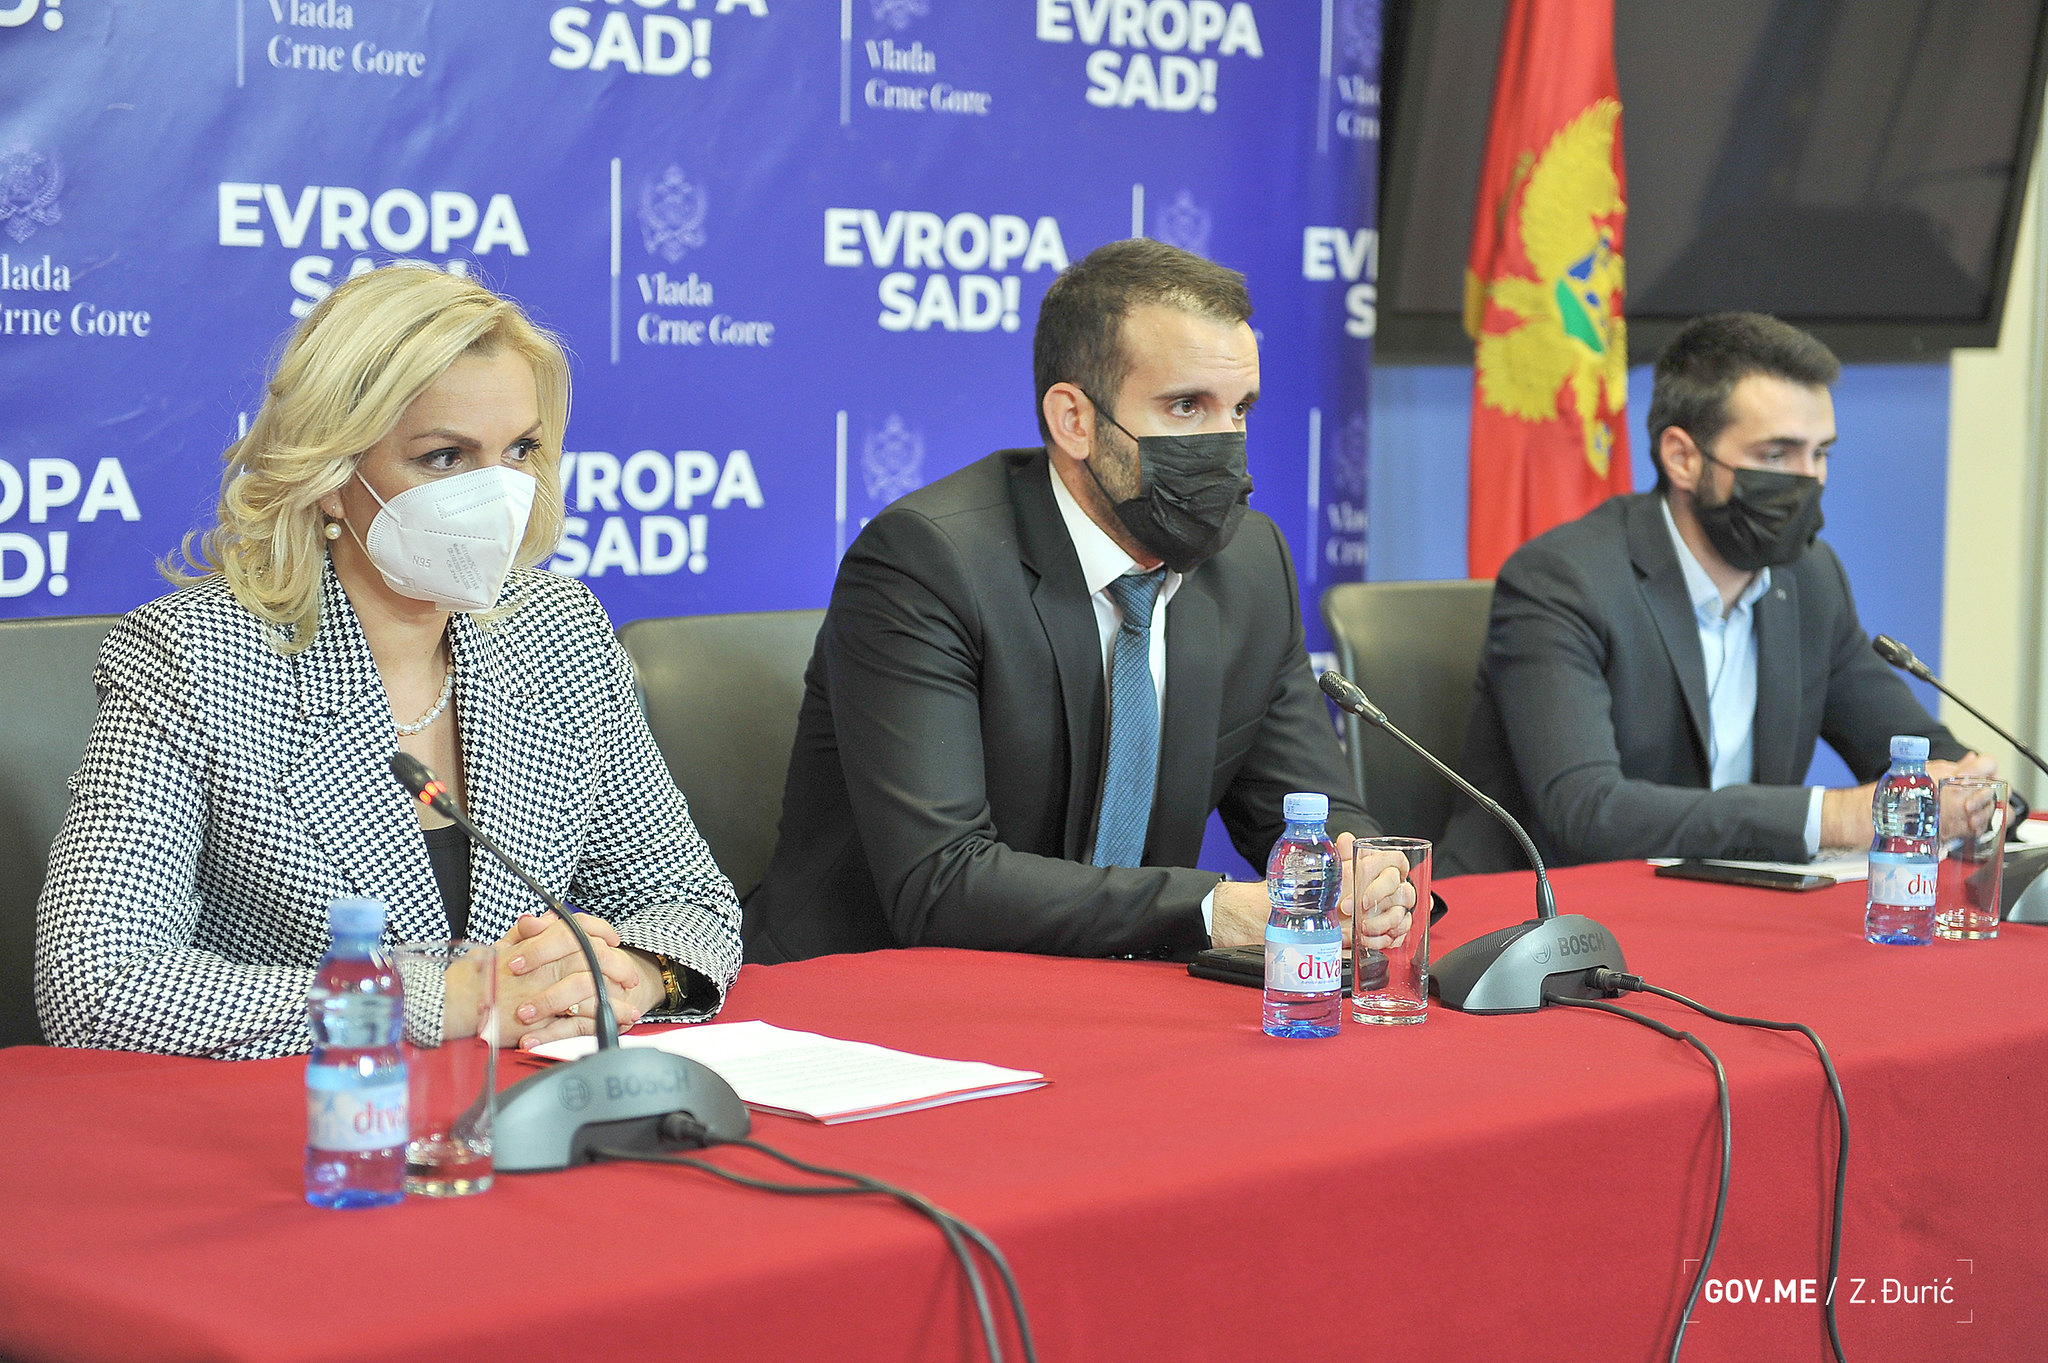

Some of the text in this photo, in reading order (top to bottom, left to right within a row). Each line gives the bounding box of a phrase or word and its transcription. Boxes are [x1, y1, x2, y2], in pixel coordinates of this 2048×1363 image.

[268, 34, 427, 78] Crne Gore
[548, 5, 712, 79] SAD!
[1035, 0, 1264, 59] EVROPA
[1085, 49, 1218, 114] SAD!
[218, 182, 530, 256] EVROPA
[824, 207, 1070, 273] EVROPA
[0, 302, 150, 337] rne Gore
[636, 271, 713, 308] Vlada
[878, 272, 1021, 334] SAD!
[412, 555, 432, 569] N95
[550, 514, 709, 577] SAD!
[1557, 931, 1606, 957] BOSCH
